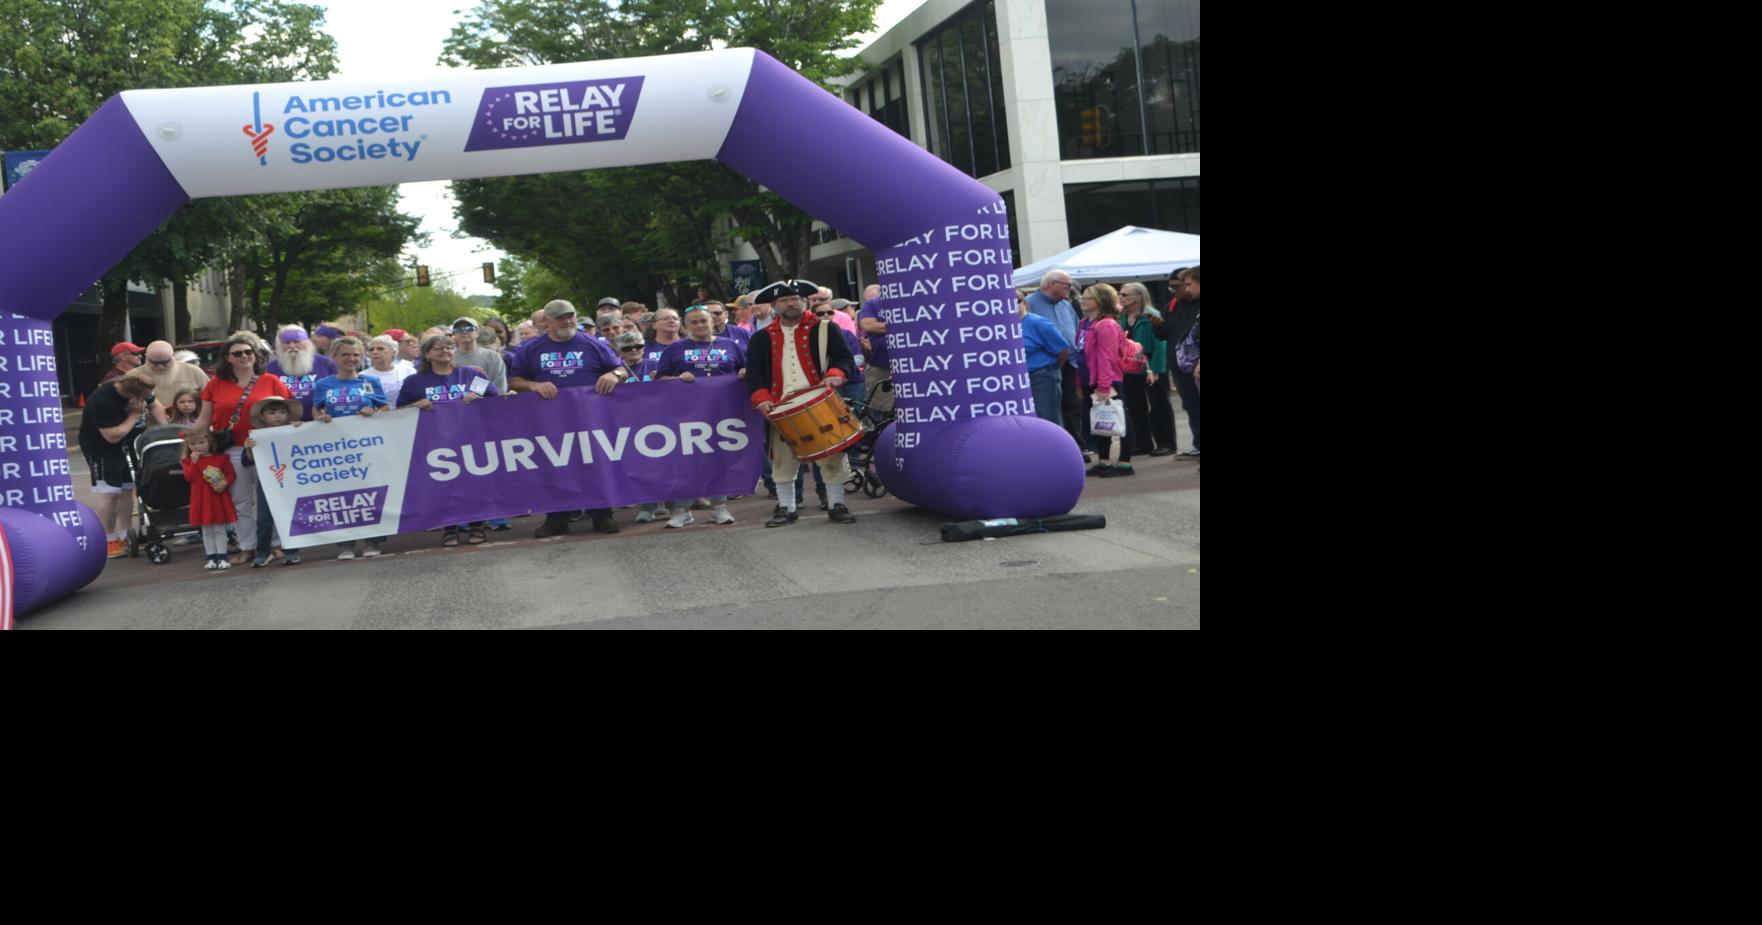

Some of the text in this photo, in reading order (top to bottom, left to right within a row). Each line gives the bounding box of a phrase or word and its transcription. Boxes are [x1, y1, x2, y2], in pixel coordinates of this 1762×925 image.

[283, 89, 451, 114] American
[514, 84, 626, 114] RELAY
[283, 113, 413, 139] Cancer
[503, 116, 541, 130] FOR
[289, 136, 422, 165] Society
[945, 223, 993, 241] FOR
[948, 249, 997, 266] FOR
[952, 274, 1000, 292] FOR
[955, 299, 1004, 318] FOR
[959, 325, 1008, 343] FOR
[540, 351, 584, 361] RELAY
[540, 360, 561, 369] FOR
[963, 350, 1012, 369] FOR
[425, 383, 466, 395] RELAY
[967, 375, 1016, 394] FOR
[970, 400, 1018, 418] FOR
[290, 435, 384, 458] American
[426, 418, 749, 481] SURVIVORS
[292, 453, 364, 471] Cancer
[296, 466, 369, 485] Society
[314, 491, 378, 514] RELAY
[308, 507, 375, 526] FOR LIFE
